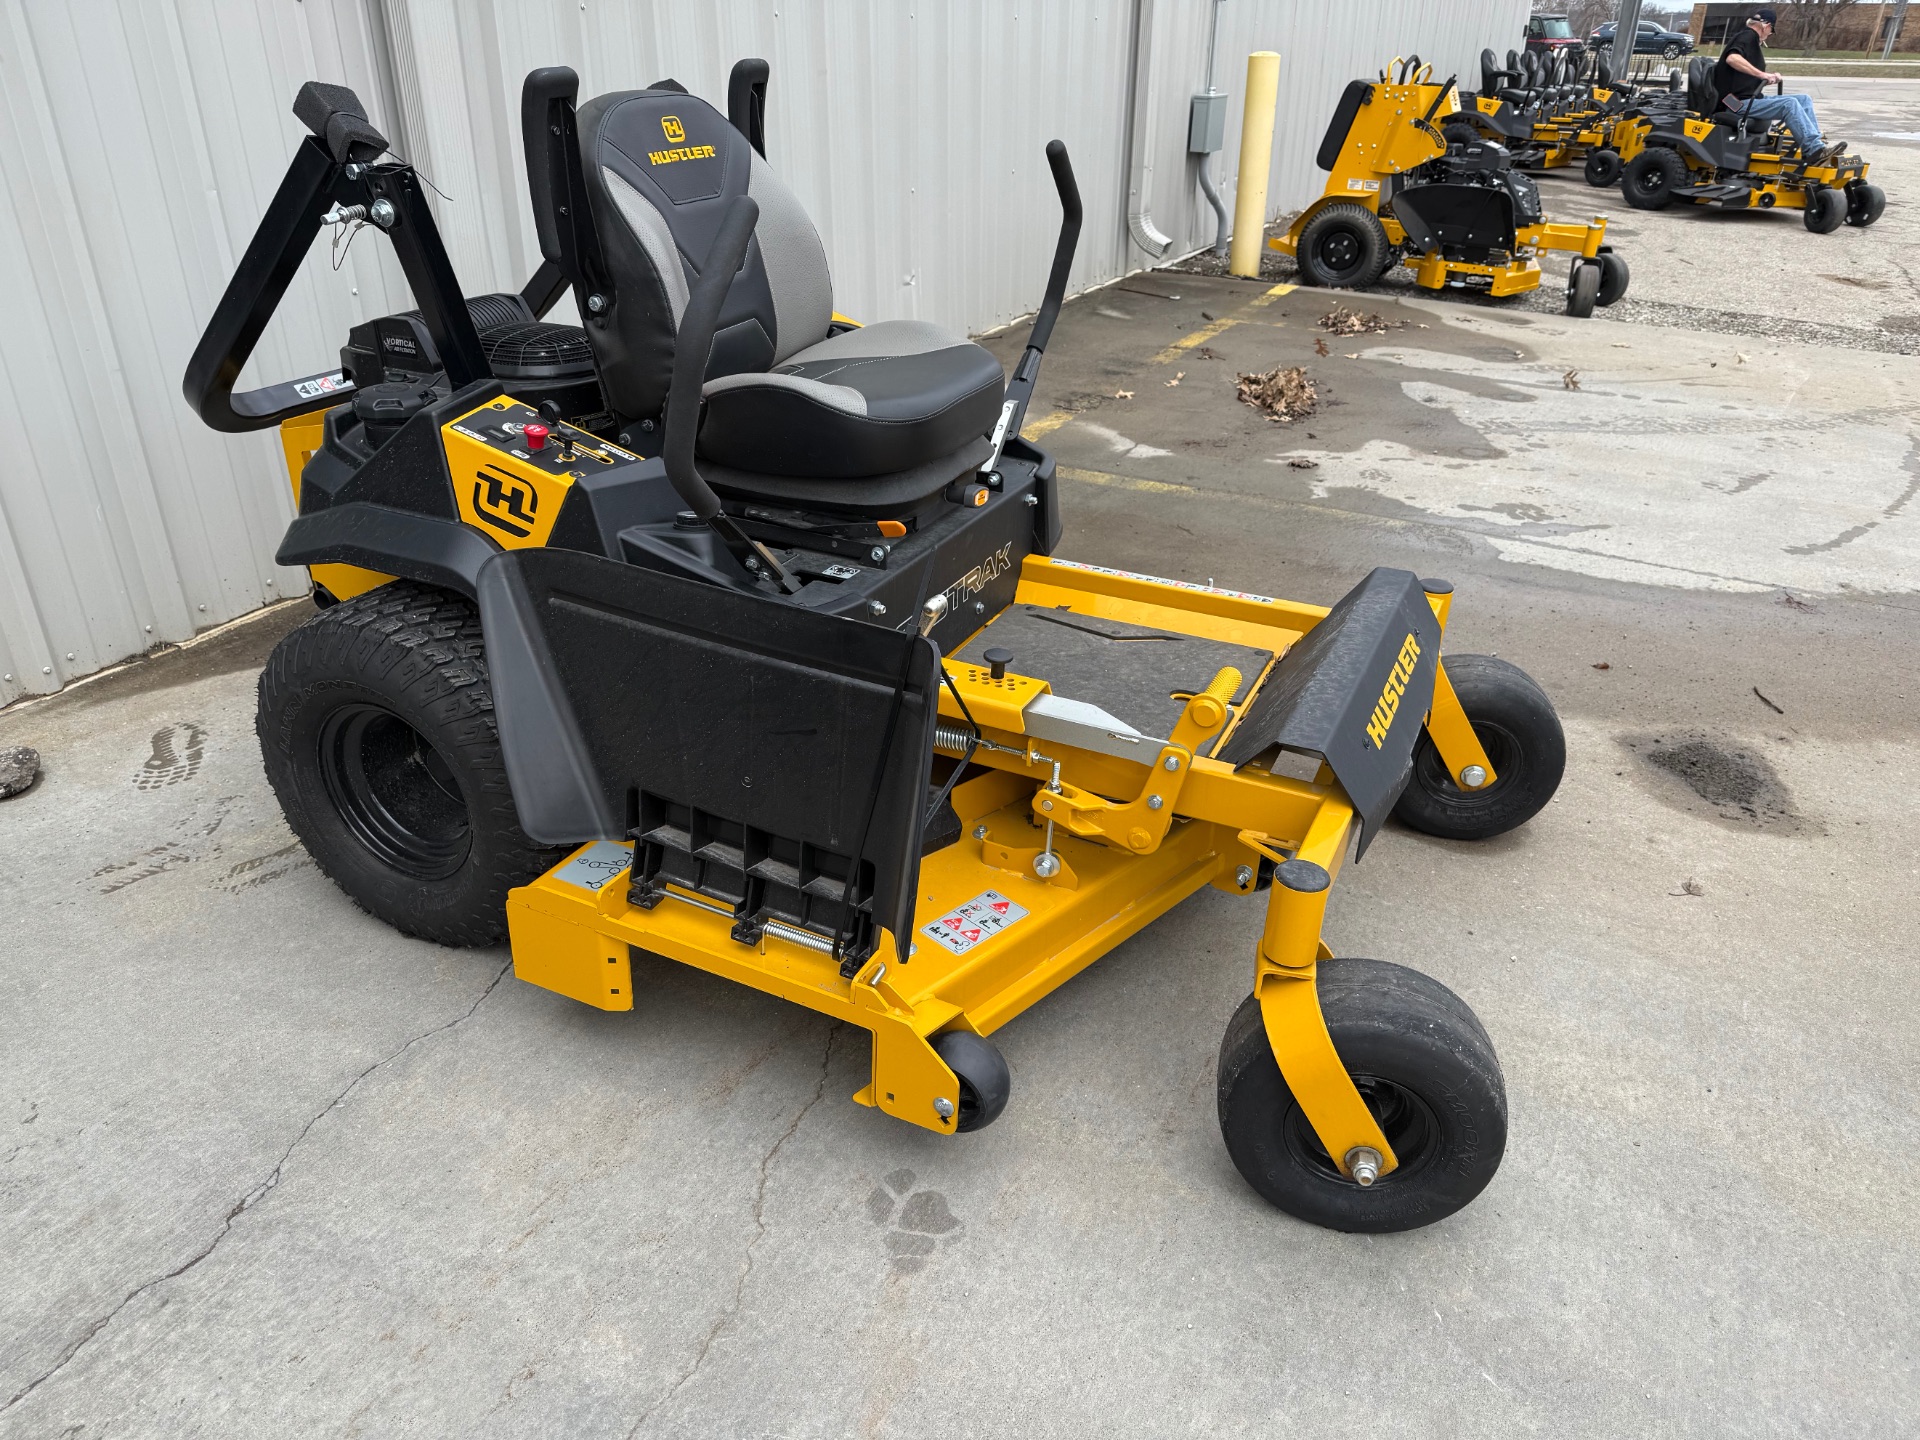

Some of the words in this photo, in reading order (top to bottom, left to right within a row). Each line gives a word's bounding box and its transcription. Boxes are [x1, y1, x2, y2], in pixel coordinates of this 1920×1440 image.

[648, 145, 716, 166] HUSTLER
[386, 337, 416, 349] VORTICAL
[1365, 633, 1421, 751] HUSTLER
